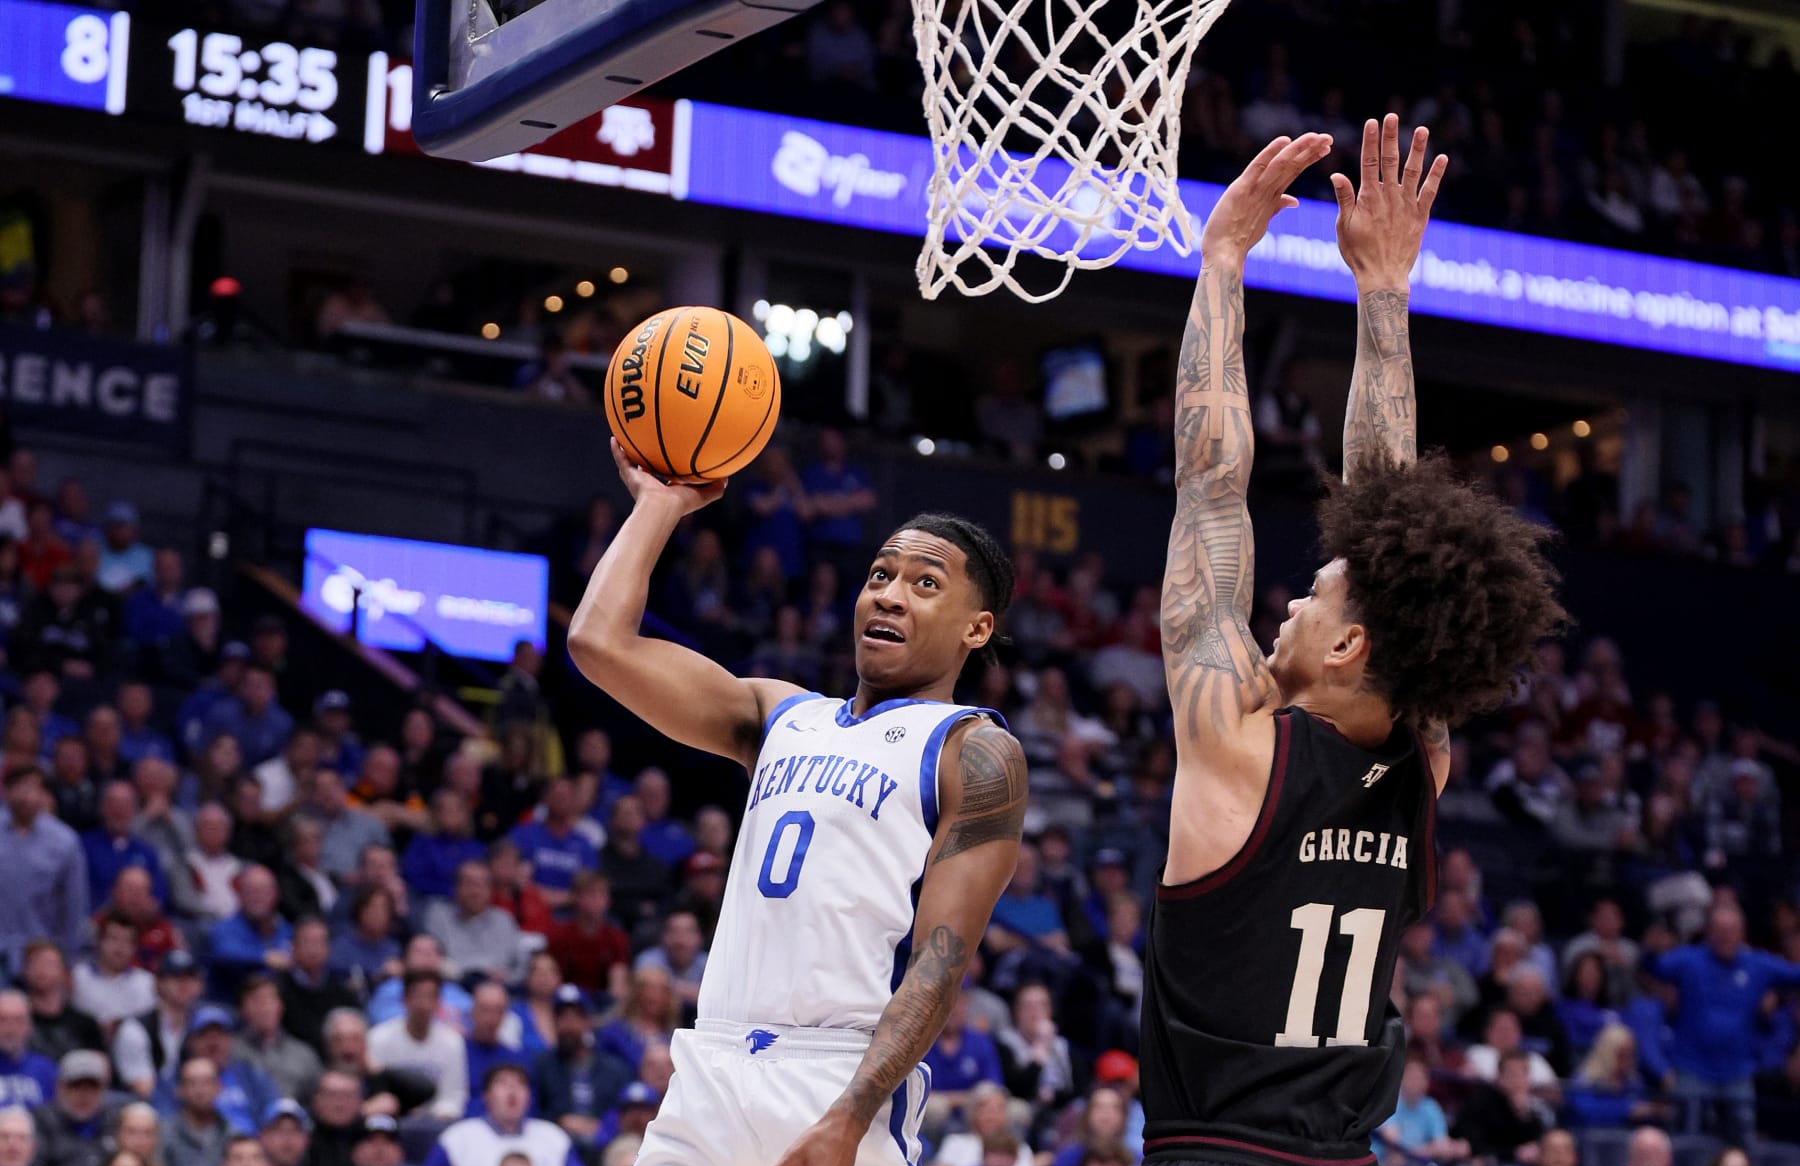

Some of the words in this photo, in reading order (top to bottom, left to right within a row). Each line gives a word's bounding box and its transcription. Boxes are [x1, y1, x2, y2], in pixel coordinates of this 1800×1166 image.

[61, 13, 110, 84] 8
[167, 28, 338, 112] 15:35
[0, 354, 179, 421] ENCE
[621, 315, 665, 424] Wilson
[676, 331, 709, 400] EVO
[1011, 489, 1079, 555] 115
[748, 754, 898, 822] KENTUCKY
[757, 810, 816, 898] 0
[1299, 828, 1408, 870] GARCIA
[1275, 903, 1386, 1049] 11
